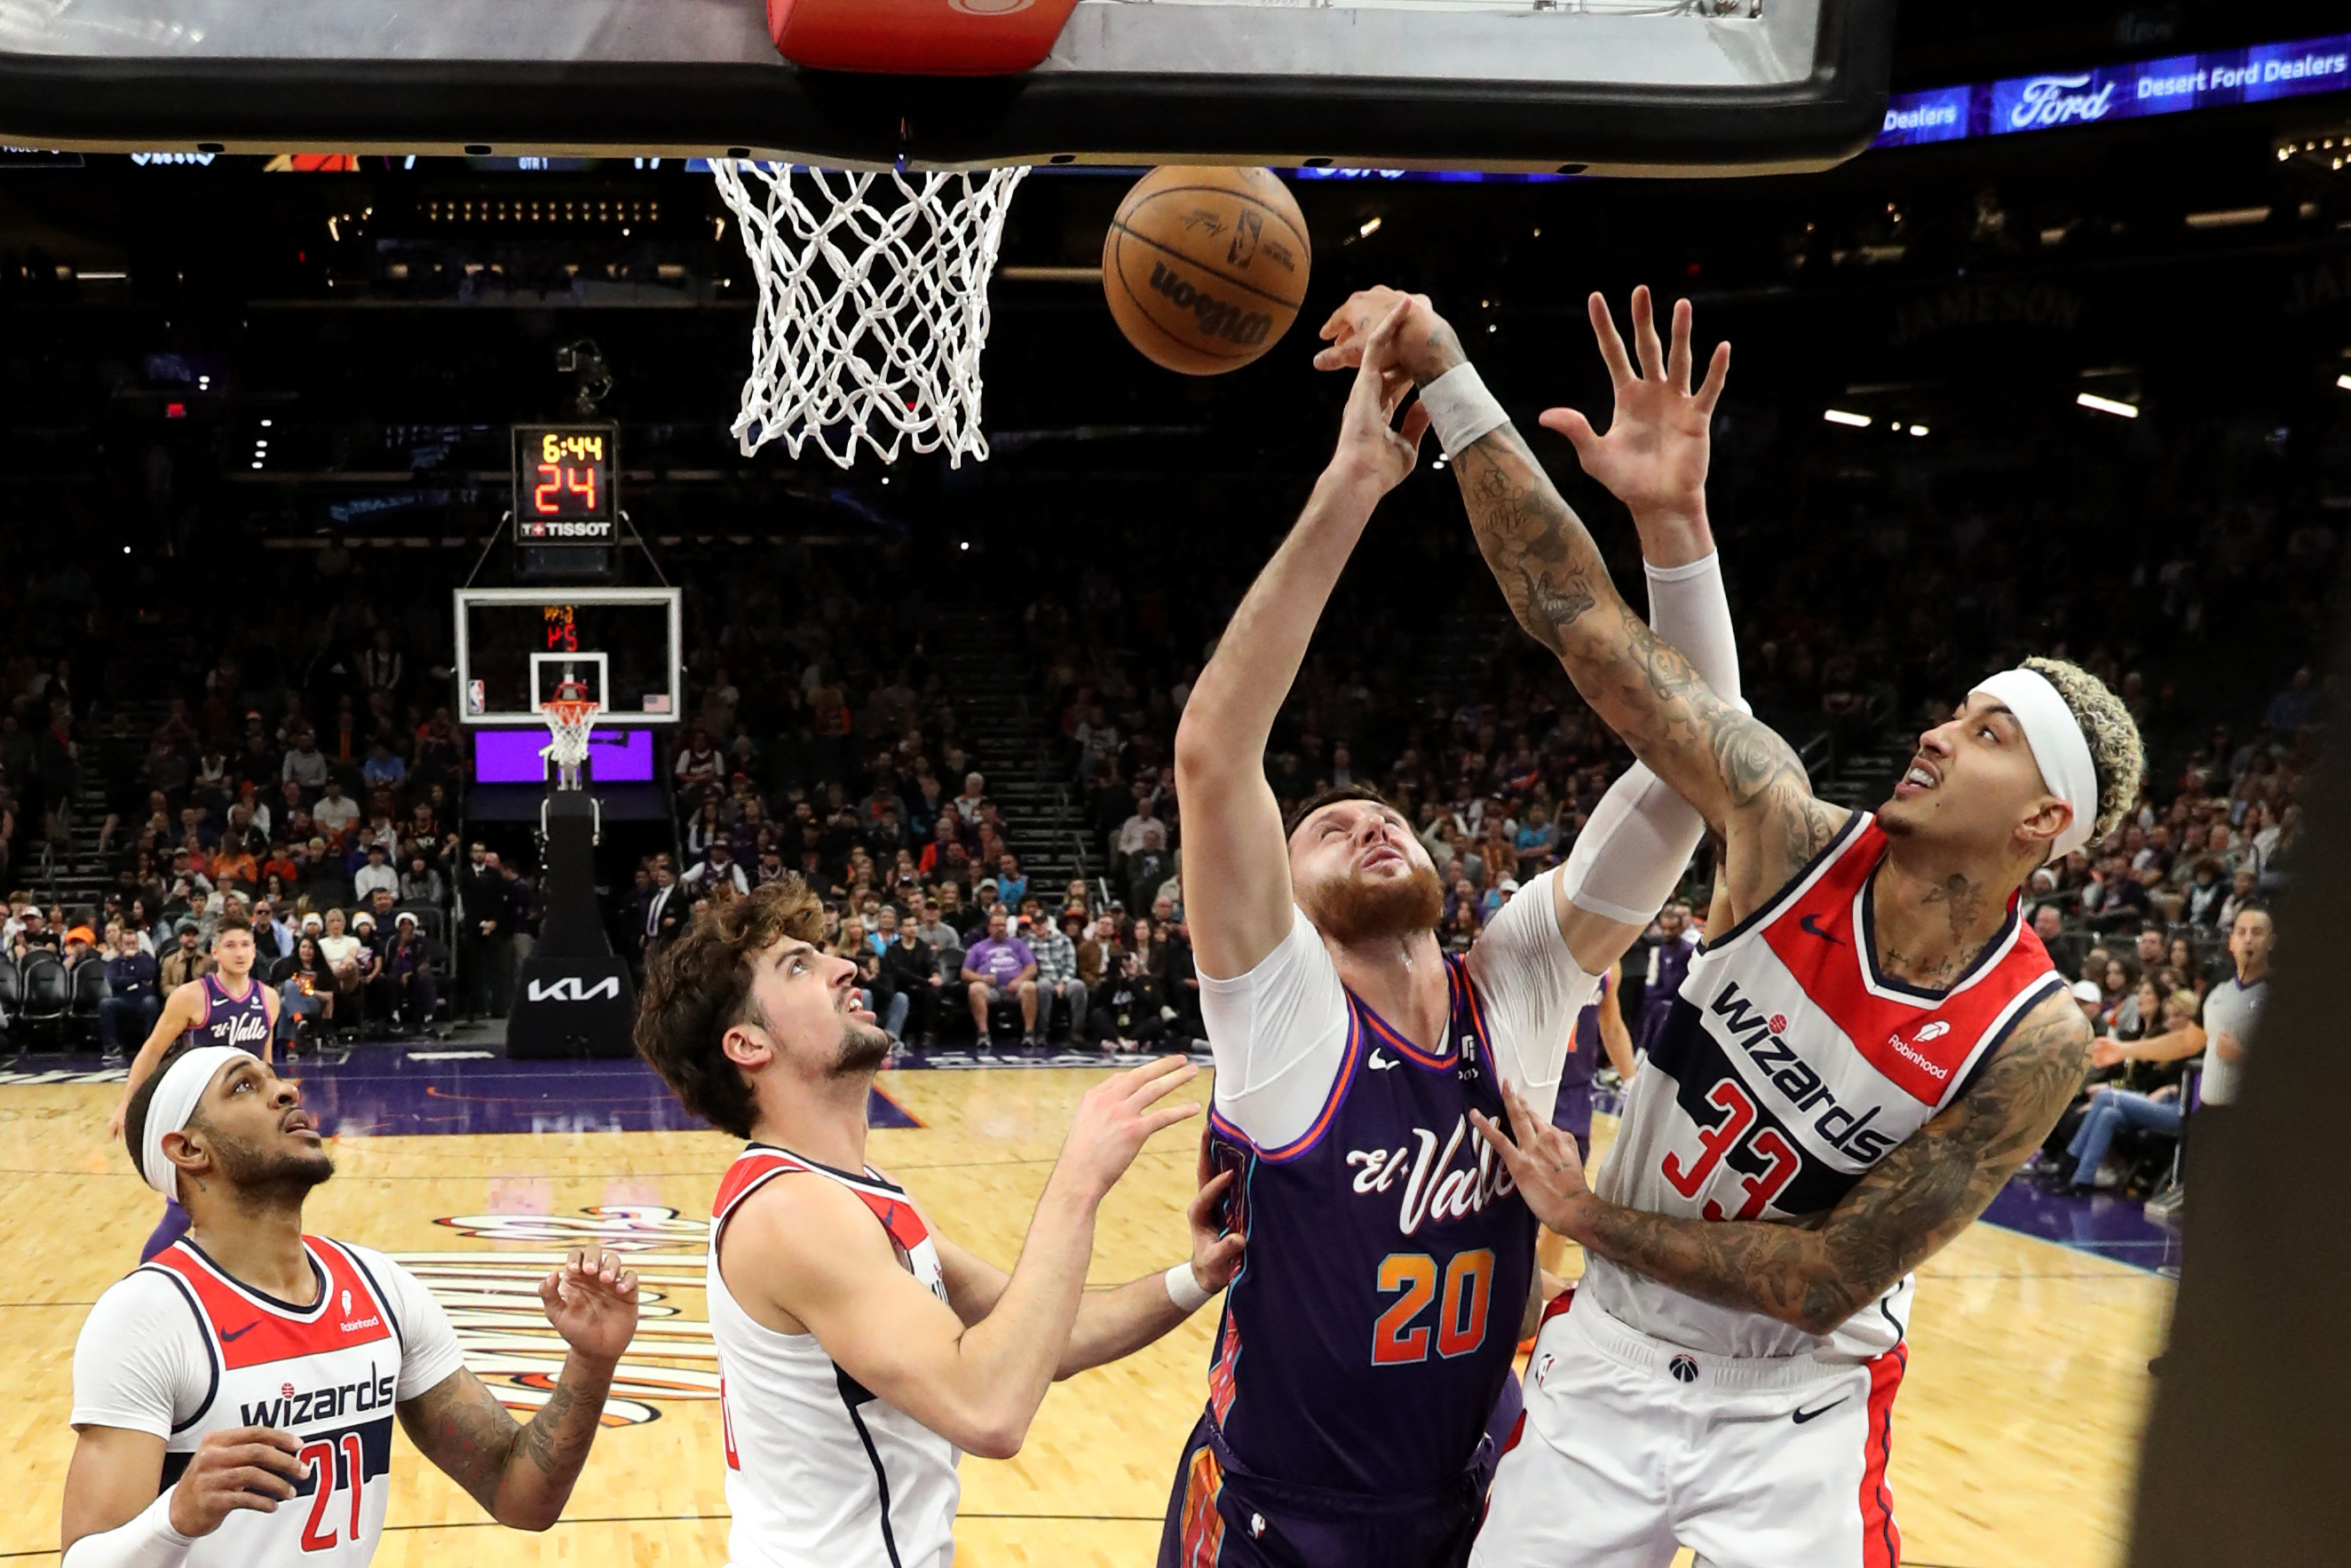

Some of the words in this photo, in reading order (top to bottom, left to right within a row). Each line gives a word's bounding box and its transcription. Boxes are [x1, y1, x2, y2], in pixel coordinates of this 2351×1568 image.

[2138, 67, 2207, 99] Desert
[2211, 61, 2260, 90] Ford
[2264, 52, 2348, 82] Dealers
[1883, 105, 1956, 132] Dealers
[2011, 75, 2116, 128] Ford
[542, 433, 602, 463] 6:44
[534, 463, 596, 514] 24
[545, 522, 611, 536] TISSOT
[527, 976, 620, 1002] KIA
[228, 1011, 267, 1046] Valle
[1888, 1033, 1949, 1080] Robinhood
[1346, 1147, 1408, 1194] El
[1662, 1078, 1801, 1223] 33
[1371, 1247, 1496, 1366] 20
[297, 1431, 365, 1554] 21
